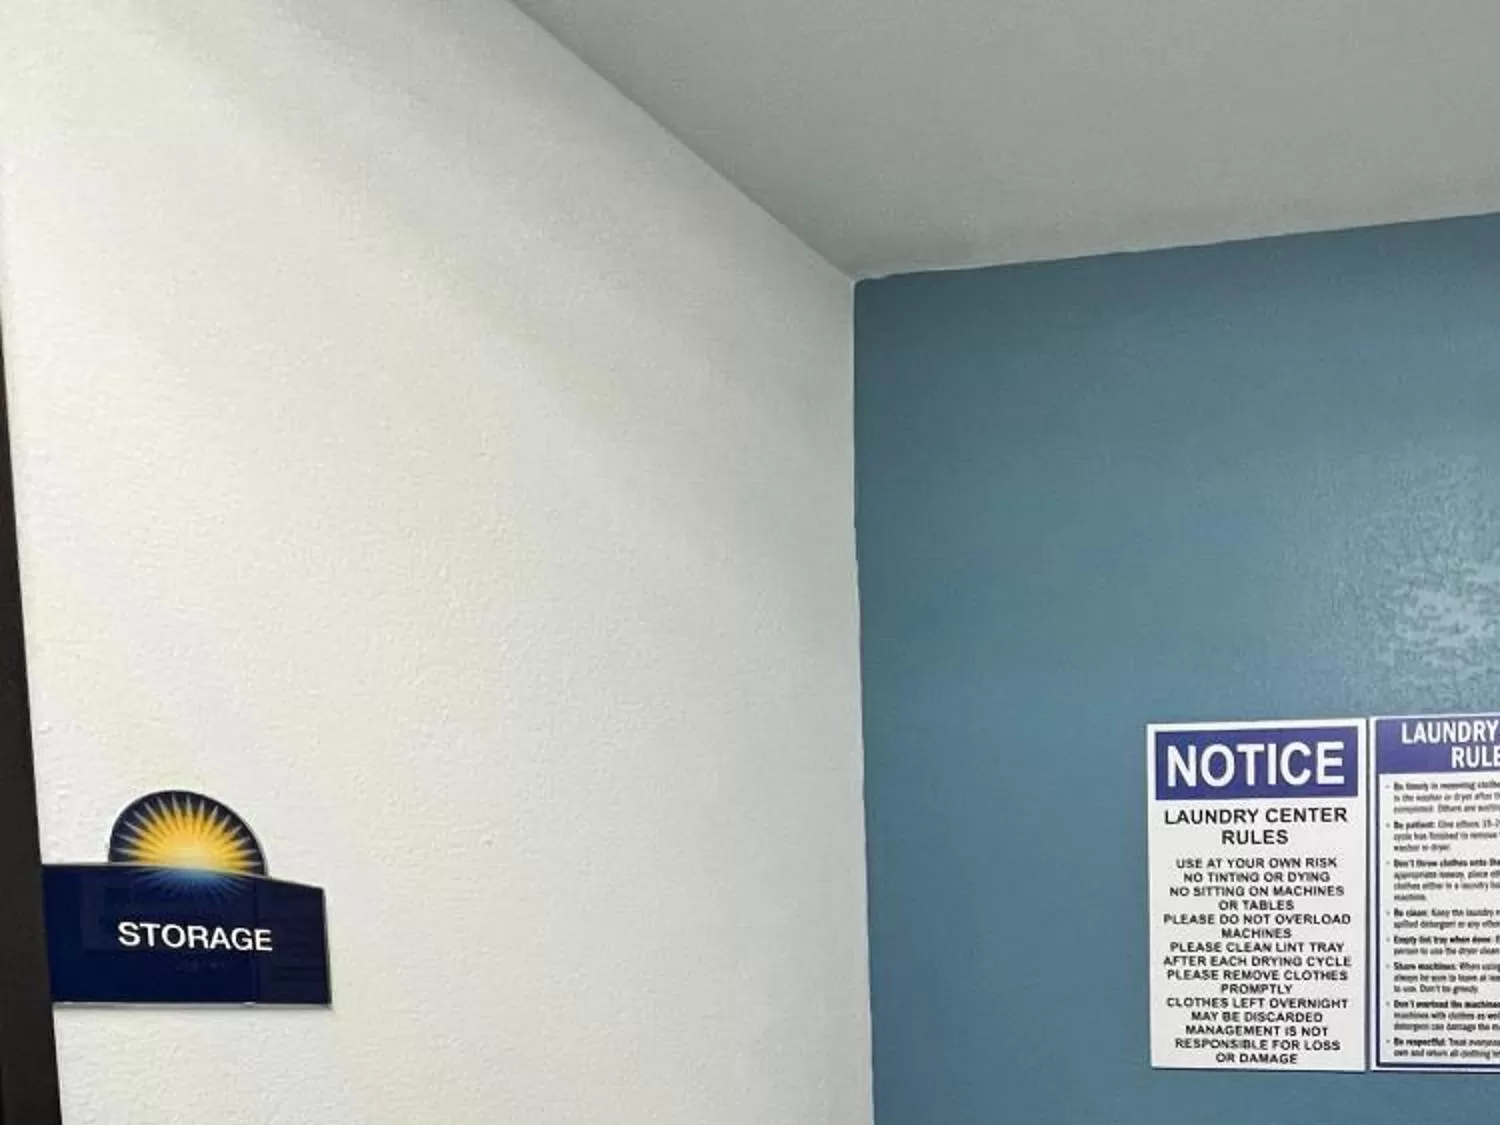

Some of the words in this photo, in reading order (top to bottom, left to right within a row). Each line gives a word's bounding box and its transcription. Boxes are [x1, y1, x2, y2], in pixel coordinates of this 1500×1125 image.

[1402, 719, 1498, 744] LAUNDRY
[1167, 741, 1345, 788] NOTICE
[1164, 808, 1258, 824] LAUNDRY
[1265, 807, 1346, 822] CENTER
[1221, 829, 1288, 844] RULES
[1176, 858, 1202, 868] USE
[1206, 858, 1222, 868] AT
[1226, 857, 1264, 868] YOUR
[1268, 857, 1301, 868] OWN
[1305, 857, 1336, 868] RISK
[1183, 872, 1203, 882] NO
[1207, 871, 1259, 882] TINTING
[1263, 871, 1284, 882] OR
[1287, 871, 1330, 882] DYING
[1169, 886, 1190, 896] NO
[1193, 886, 1244, 896] SITTING
[1248, 886, 1268, 896] ON
[1272, 885, 1344, 896] MACHINES
[1218, 899, 1238, 910] OR
[1242, 899, 1294, 910] TABLES
[1163, 913, 1215, 924] PLEASE
[1219, 913, 1239, 924] DO
[1242, 913, 1270, 924] NOT
[1274, 913, 1350, 924] OVERLOAD
[117, 921, 273, 951] STORAGE
[1221, 927, 1291, 938] MACHINES
[1169, 941, 1222, 952] PLEASE
[1225, 942, 1272, 952] CLEAN
[1275, 942, 1304, 952] LINT
[1309, 942, 1343, 952] TRAY
[1163, 955, 1206, 966] AFTER
[1209, 955, 1247, 966] EACH
[1251, 956, 1302, 966] DRYING
[1305, 956, 1351, 966] CYCLE
[1167, 969, 1218, 980] PLEASE
[1222, 969, 1280, 980] REMOVE
[1283, 969, 1347, 980] CLOTHES
[1220, 983, 1292, 994] PROMPTLY
[1166, 997, 1228, 1008] CLOTHES
[1231, 997, 1265, 1008] LEFT
[1269, 997, 1347, 1008] OVERNIGHT
[1191, 1011, 1218, 1020] MAY
[1221, 1011, 1240, 1022] BE
[1243, 1011, 1322, 1022] DISCARDED
[1185, 1025, 1280, 1036] MANAGEMENT
[1284, 1025, 1296, 1036] IS
[1300, 1026, 1327, 1036] NOT
[1174, 1038, 1268, 1050] RESPONSIBLE
[1271, 1039, 1300, 1050] FOR
[1303, 1039, 1340, 1050] LOSS
[1215, 1052, 1235, 1062] OR
[1239, 1052, 1297, 1064] DAMAGE
